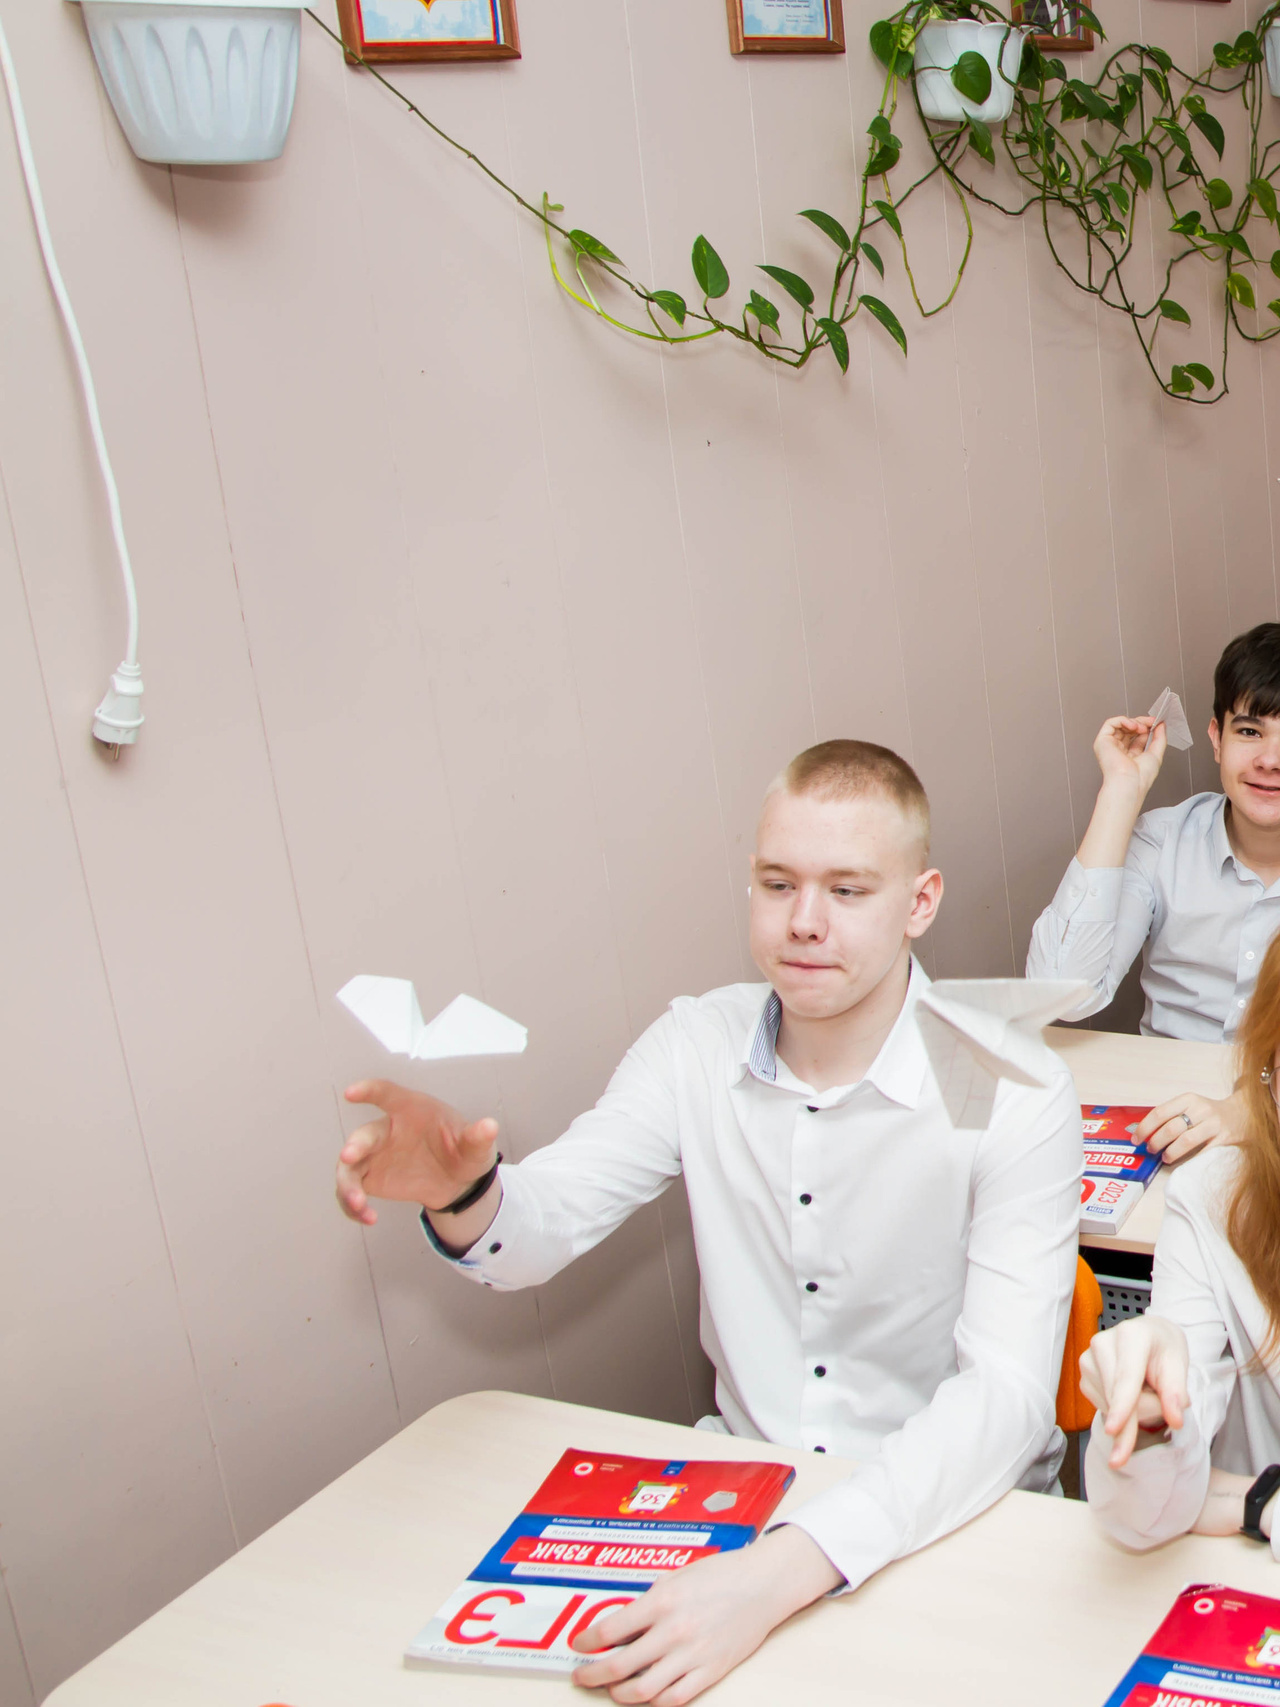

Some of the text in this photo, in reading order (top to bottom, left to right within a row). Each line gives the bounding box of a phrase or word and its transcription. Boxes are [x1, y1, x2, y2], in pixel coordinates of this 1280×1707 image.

[1098, 1181, 1128, 1204] 2023
[639, 1493, 667, 1505] 36
[529, 1542, 694, 1568] РУССКИЙ ЯЗЫК
